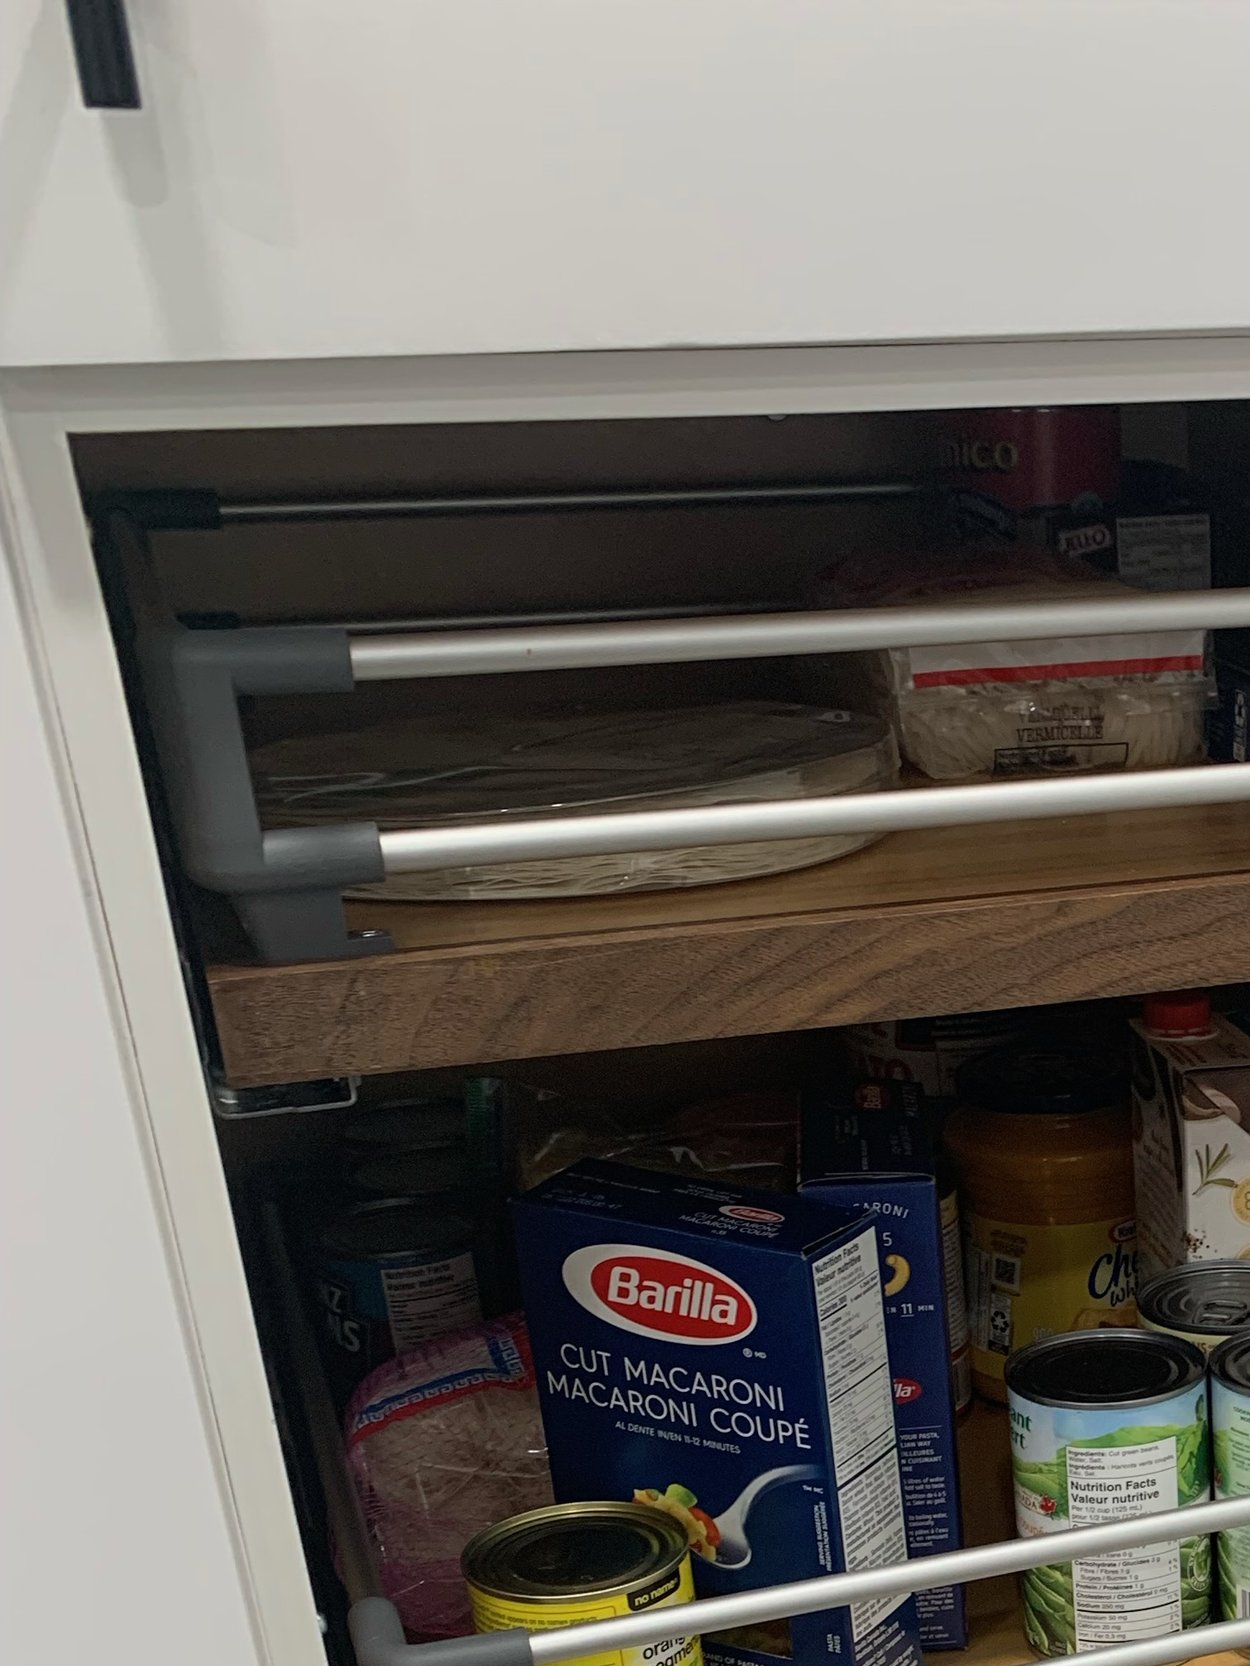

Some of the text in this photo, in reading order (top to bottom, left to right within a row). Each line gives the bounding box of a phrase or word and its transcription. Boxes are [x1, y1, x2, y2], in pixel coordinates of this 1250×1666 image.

[882, 1232, 893, 1247] 5
[606, 1265, 739, 1326] Barilla
[900, 1303, 914, 1316] 11
[560, 1343, 785, 1412] CUT MACARONI
[546, 1370, 812, 1449] MACARONI COUPÉ
[615, 1420, 626, 1430] AL
[627, 1423, 655, 1437] DENTE
[702, 1440, 742, 1455] MINUTES
[1070, 1478, 1157, 1492] Nutrition Facts
[1071, 1489, 1160, 1504] Valeur nutritive
[1085, 1505, 1096, 1513] 1/2
[634, 1592, 650, 1607] no
